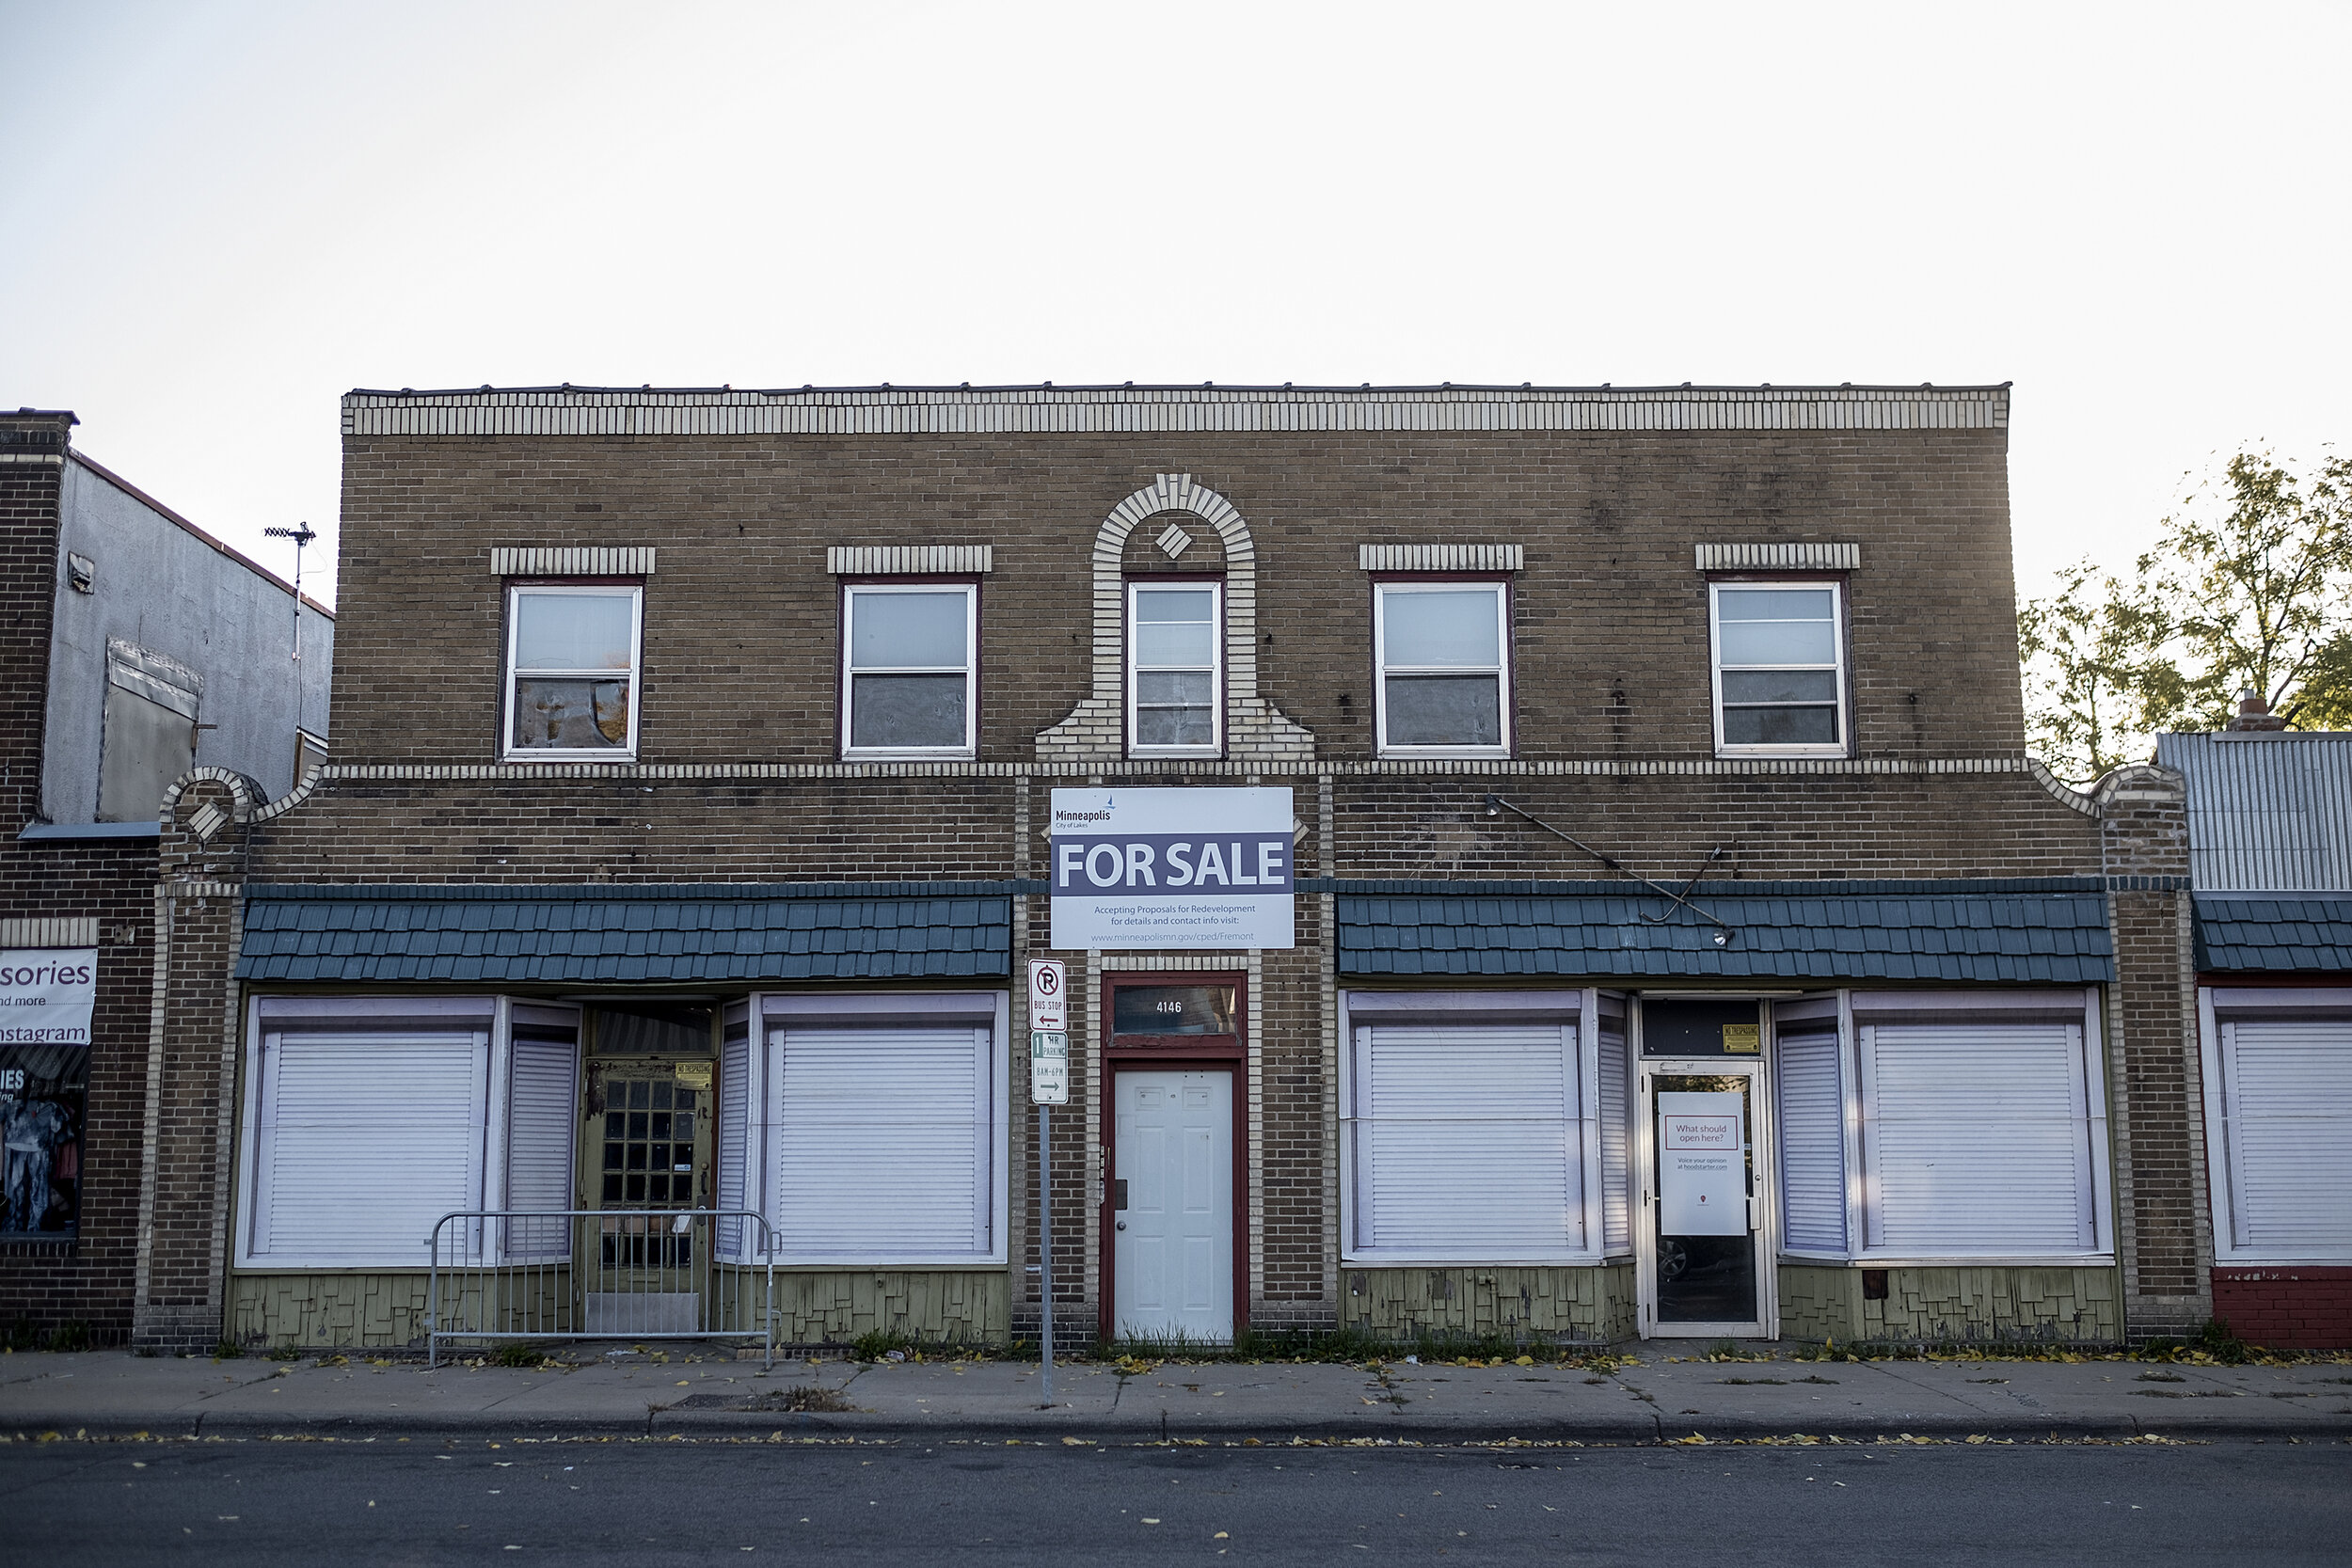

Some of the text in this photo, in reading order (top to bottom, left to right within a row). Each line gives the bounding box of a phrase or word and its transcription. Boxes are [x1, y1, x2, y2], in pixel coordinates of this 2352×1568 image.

[1056, 810, 1111, 823] Minneapolis
[1058, 842, 1285, 887] FOR SALE
[1094, 905, 1256, 916] Accepting Proposals for Redevelopment
[1111, 916, 1240, 926] for details and contact info visit:
[1091, 931, 1254, 942] www.minneapolismn.gov/cped/Fremont
[0, 959, 90, 986] sories
[15, 997, 46, 1006] more
[1035, 1001, 1062, 1011] BUS STOP
[1156, 1001, 1182, 1013] 4146
[1035, 1037, 1040, 1054] 1
[1049, 1036, 1059, 1045] HR
[1043, 1047, 1065, 1056] PARKING
[1037, 1067, 1064, 1077] 8AM-6PM
[1676, 1124, 1727, 1132] What should
[1701, 1133, 1724, 1142] here?
